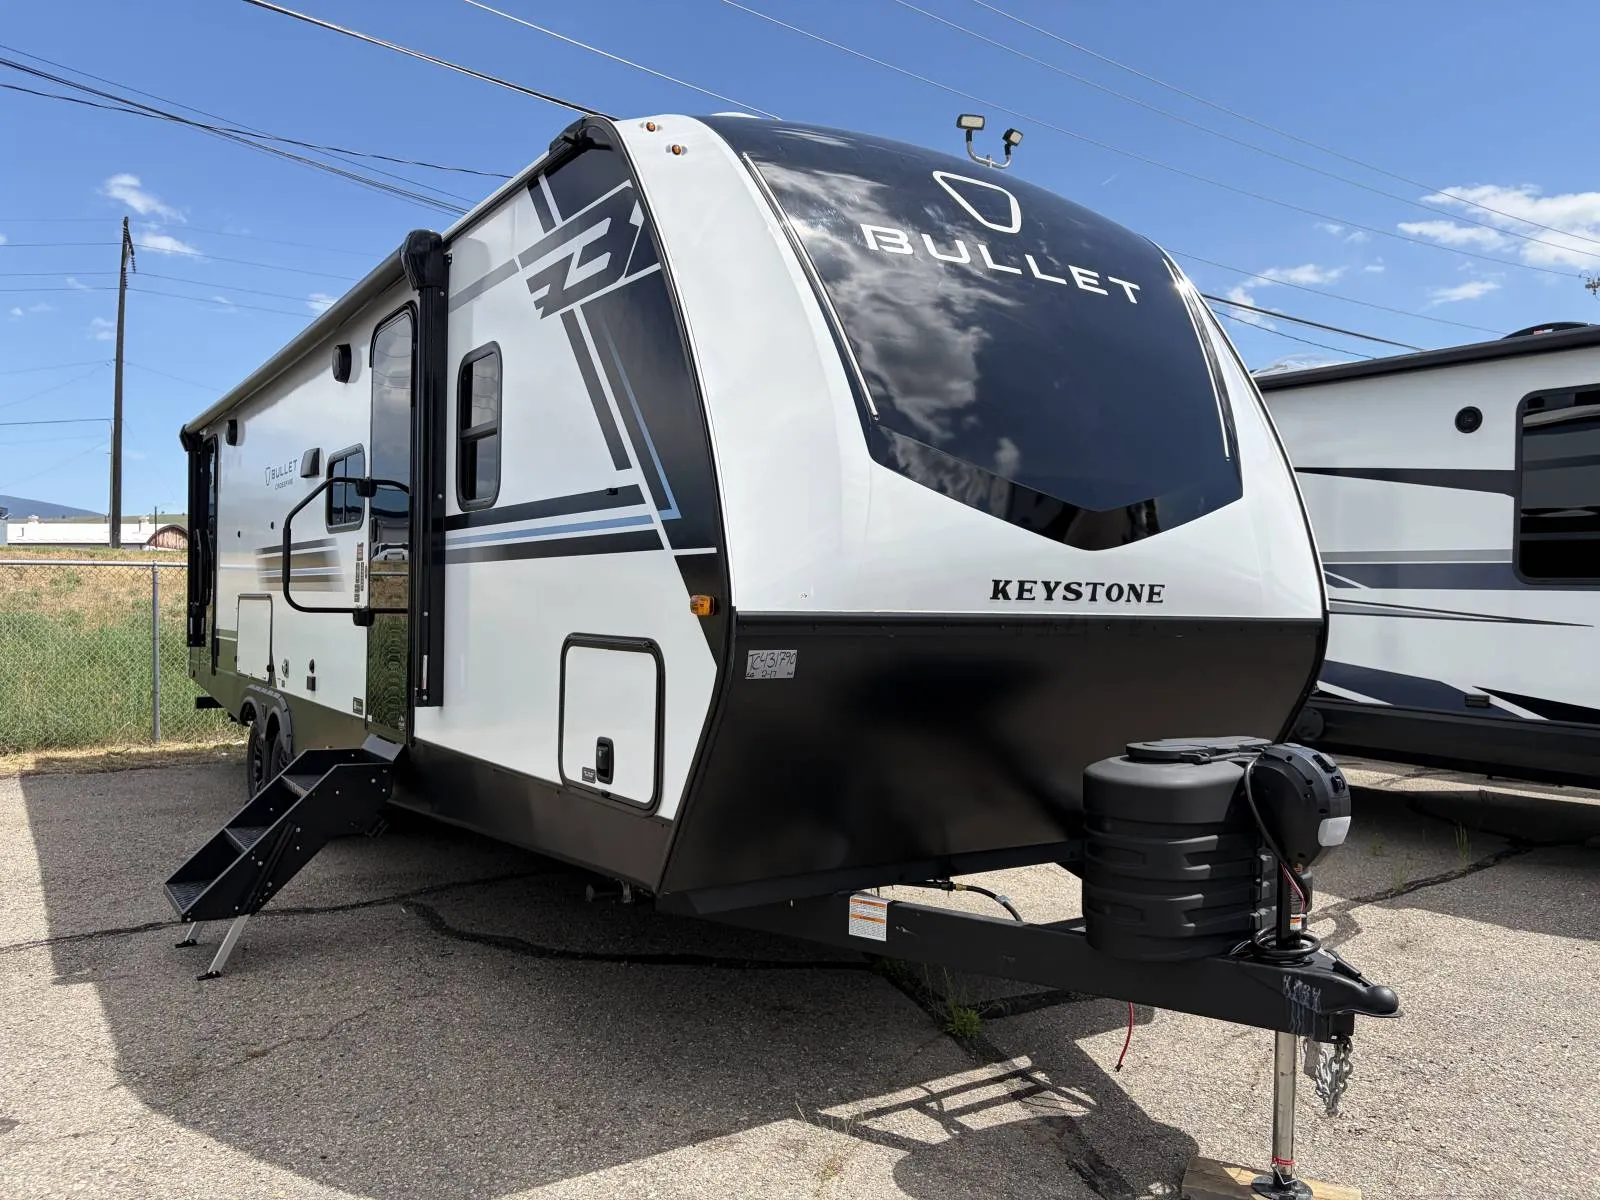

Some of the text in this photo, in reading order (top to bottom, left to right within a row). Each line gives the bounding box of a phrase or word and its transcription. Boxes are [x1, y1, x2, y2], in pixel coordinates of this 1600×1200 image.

[860, 223, 1141, 304] BULLET
[271, 459, 298, 479] BULLET
[990, 579, 1166, 603] KEYSTONE
